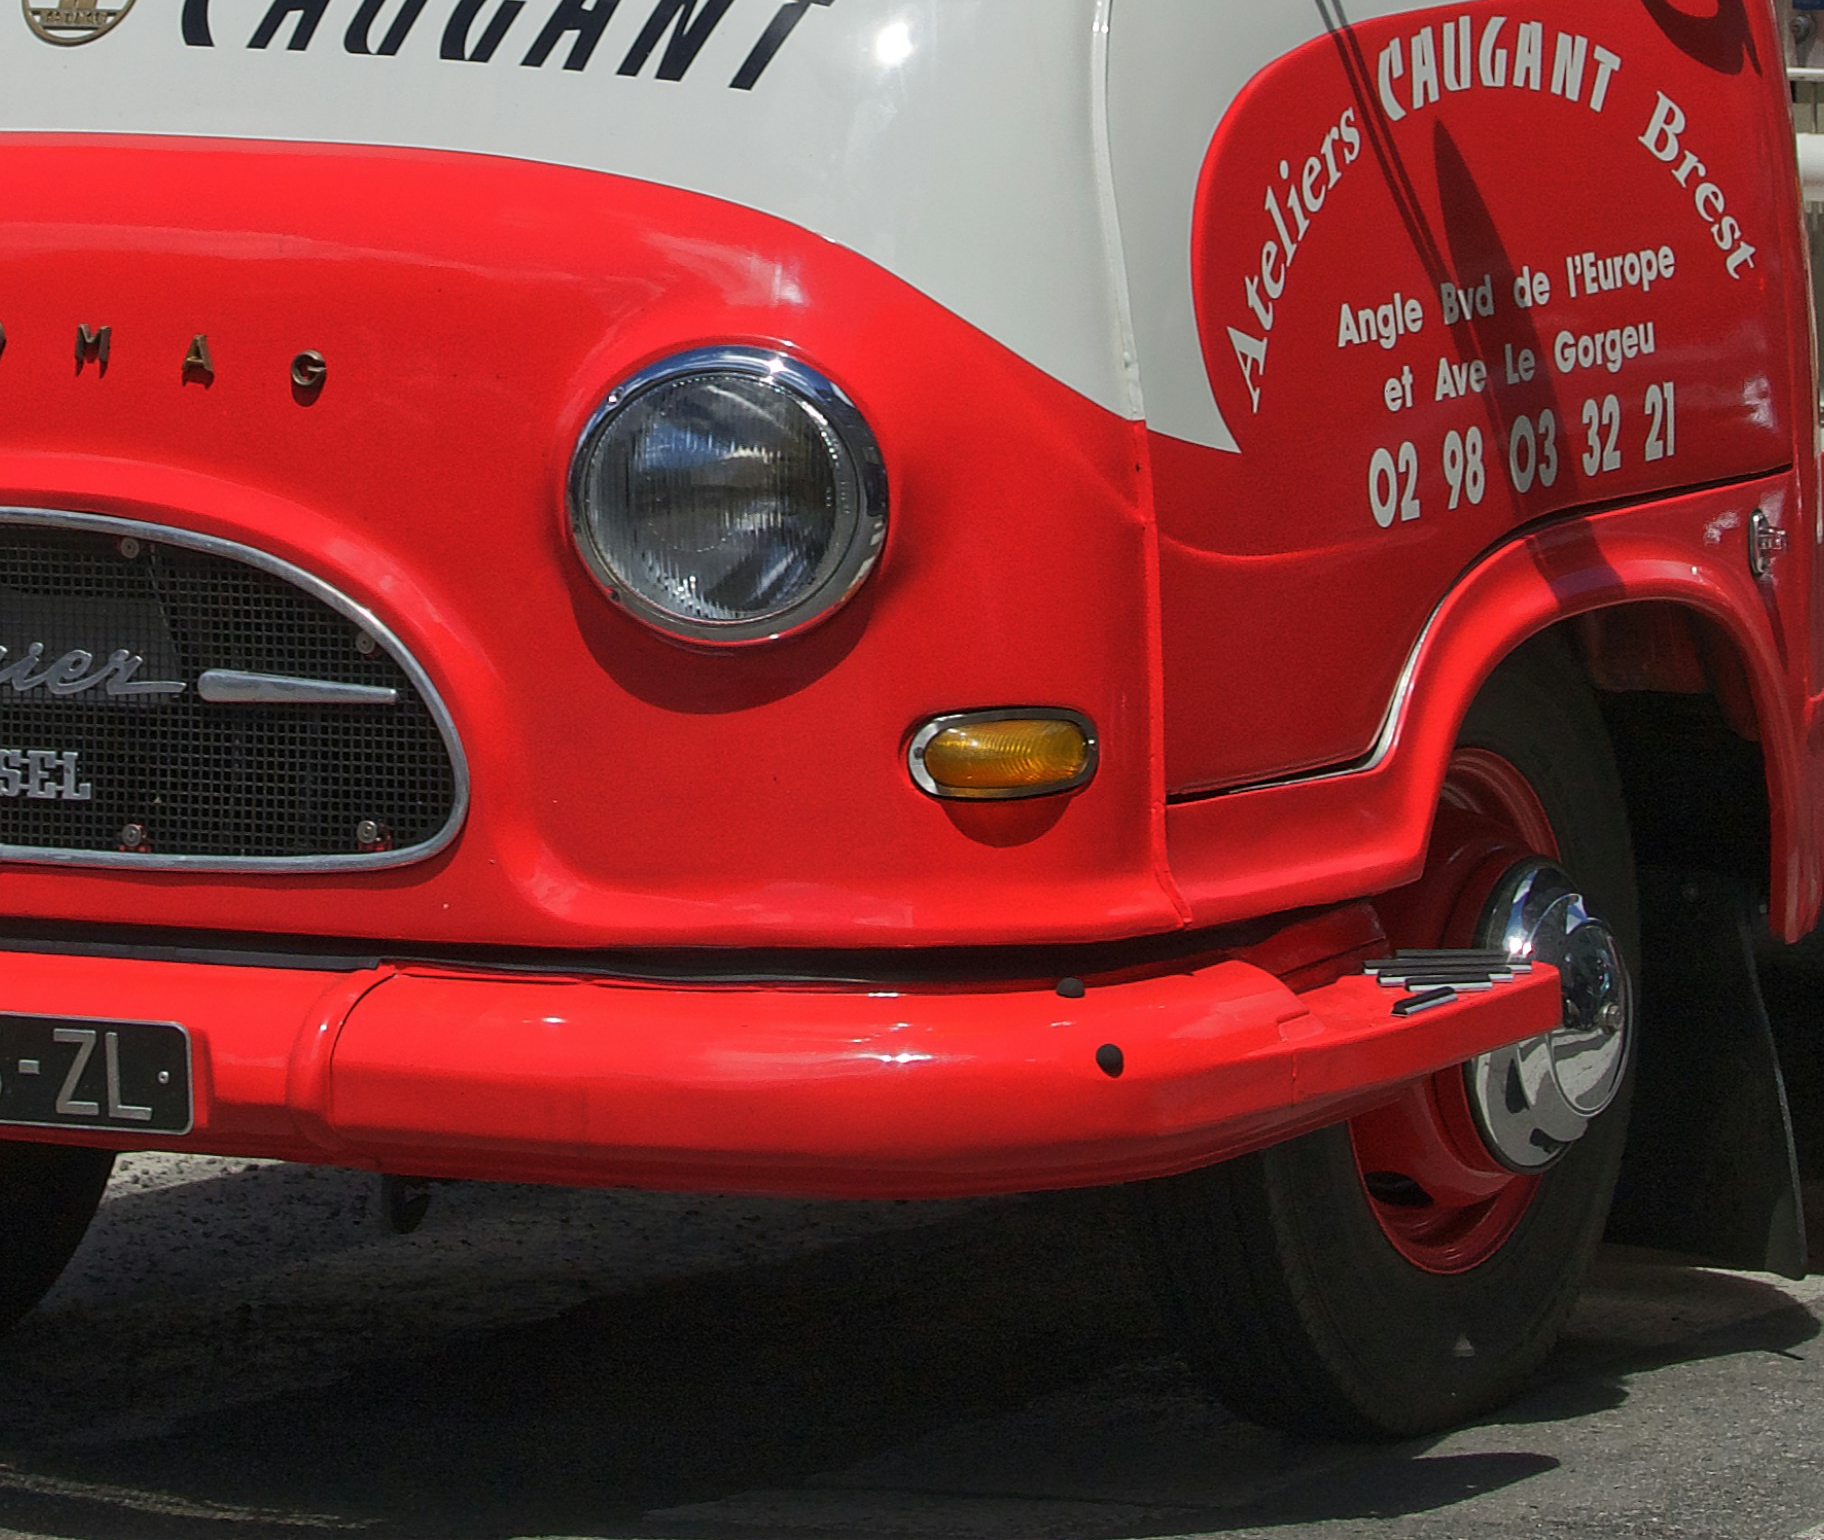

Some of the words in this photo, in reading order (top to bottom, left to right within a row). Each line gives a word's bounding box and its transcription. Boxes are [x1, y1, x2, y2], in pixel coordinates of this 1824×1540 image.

[1225, 105, 1362, 414] Ateliers
[1377, 15, 1622, 122] CAUGANT
[1638, 90, 1757, 280] Brest
[1336, 293, 1424, 350] Angle
[1441, 274, 1495, 325] Bvd
[1513, 265, 1551, 310] de
[1567, 243, 1676, 298] l'Europe
[1383, 365, 1415, 412] et
[1434, 356, 1488, 402] Ave
[1505, 343, 1536, 386] Le
[1553, 320, 1656, 374] Gorgeu
[1368, 441, 1421, 528] 02
[1442, 425, 1485, 511] 98
[1508, 407, 1558, 494] 03
[1581, 393, 1622, 477] 32
[1643, 380, 1676, 463] 21
